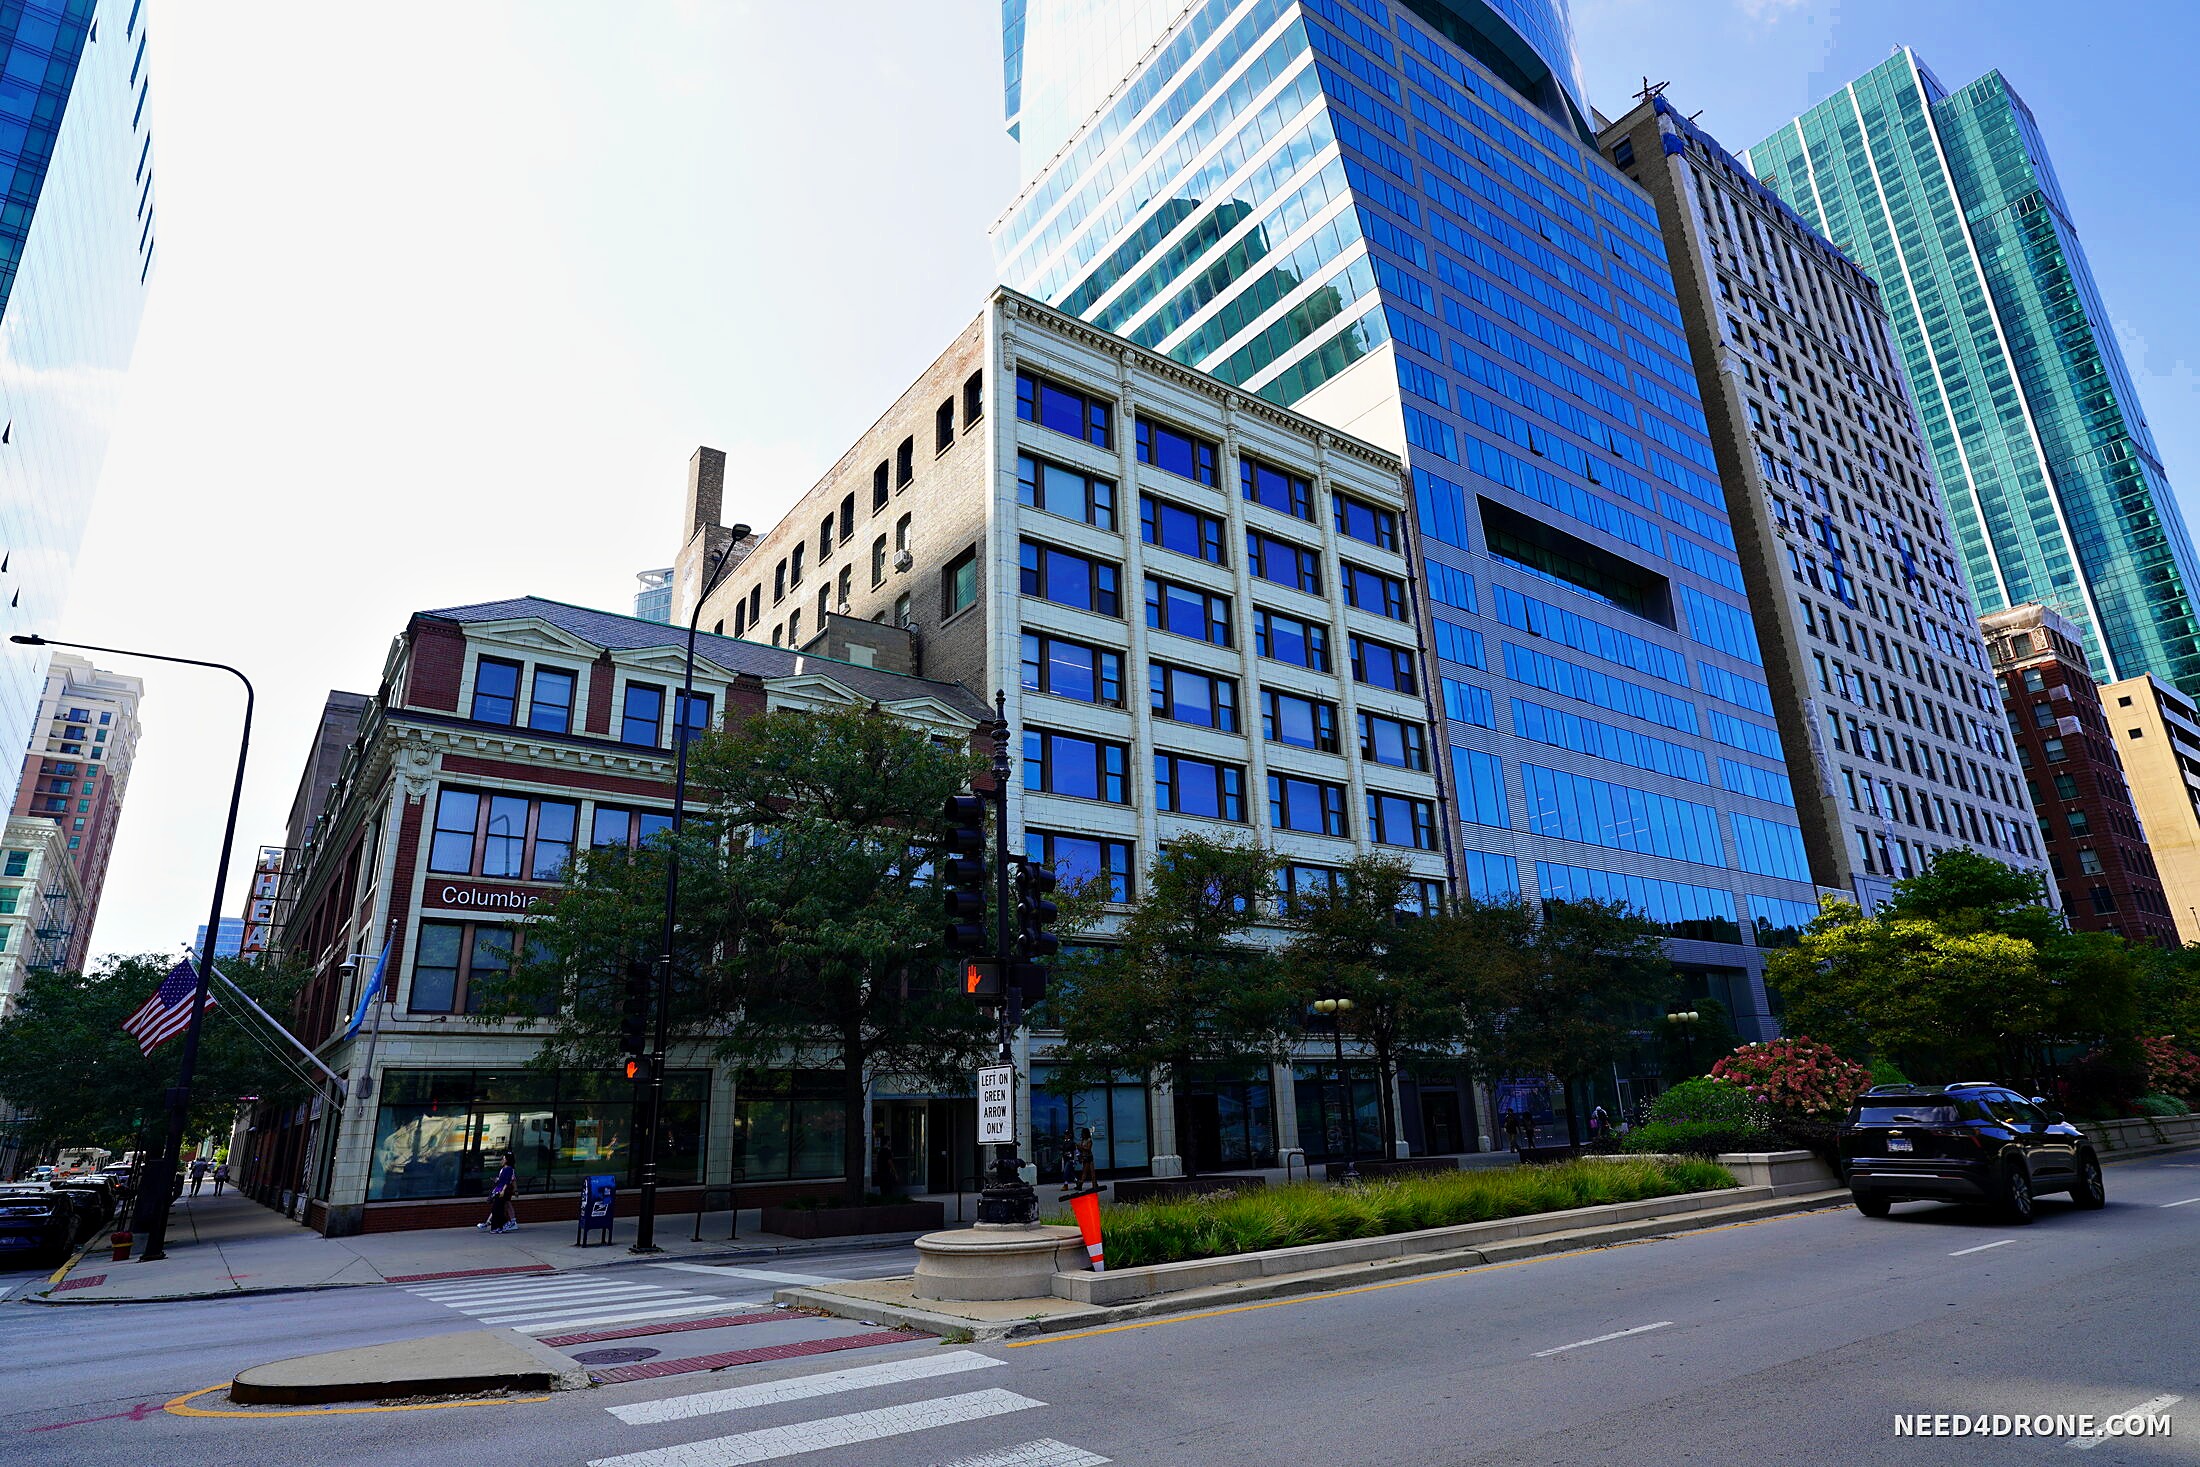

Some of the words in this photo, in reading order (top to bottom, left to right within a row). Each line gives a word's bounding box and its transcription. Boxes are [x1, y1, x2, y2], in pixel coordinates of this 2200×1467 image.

[982, 1074, 997, 1087] LEFT
[999, 1073, 1009, 1085] ON
[984, 1090, 1006, 1102] GREEN
[984, 1106, 1007, 1118] ARROW
[987, 1123, 1004, 1134] ONLY
